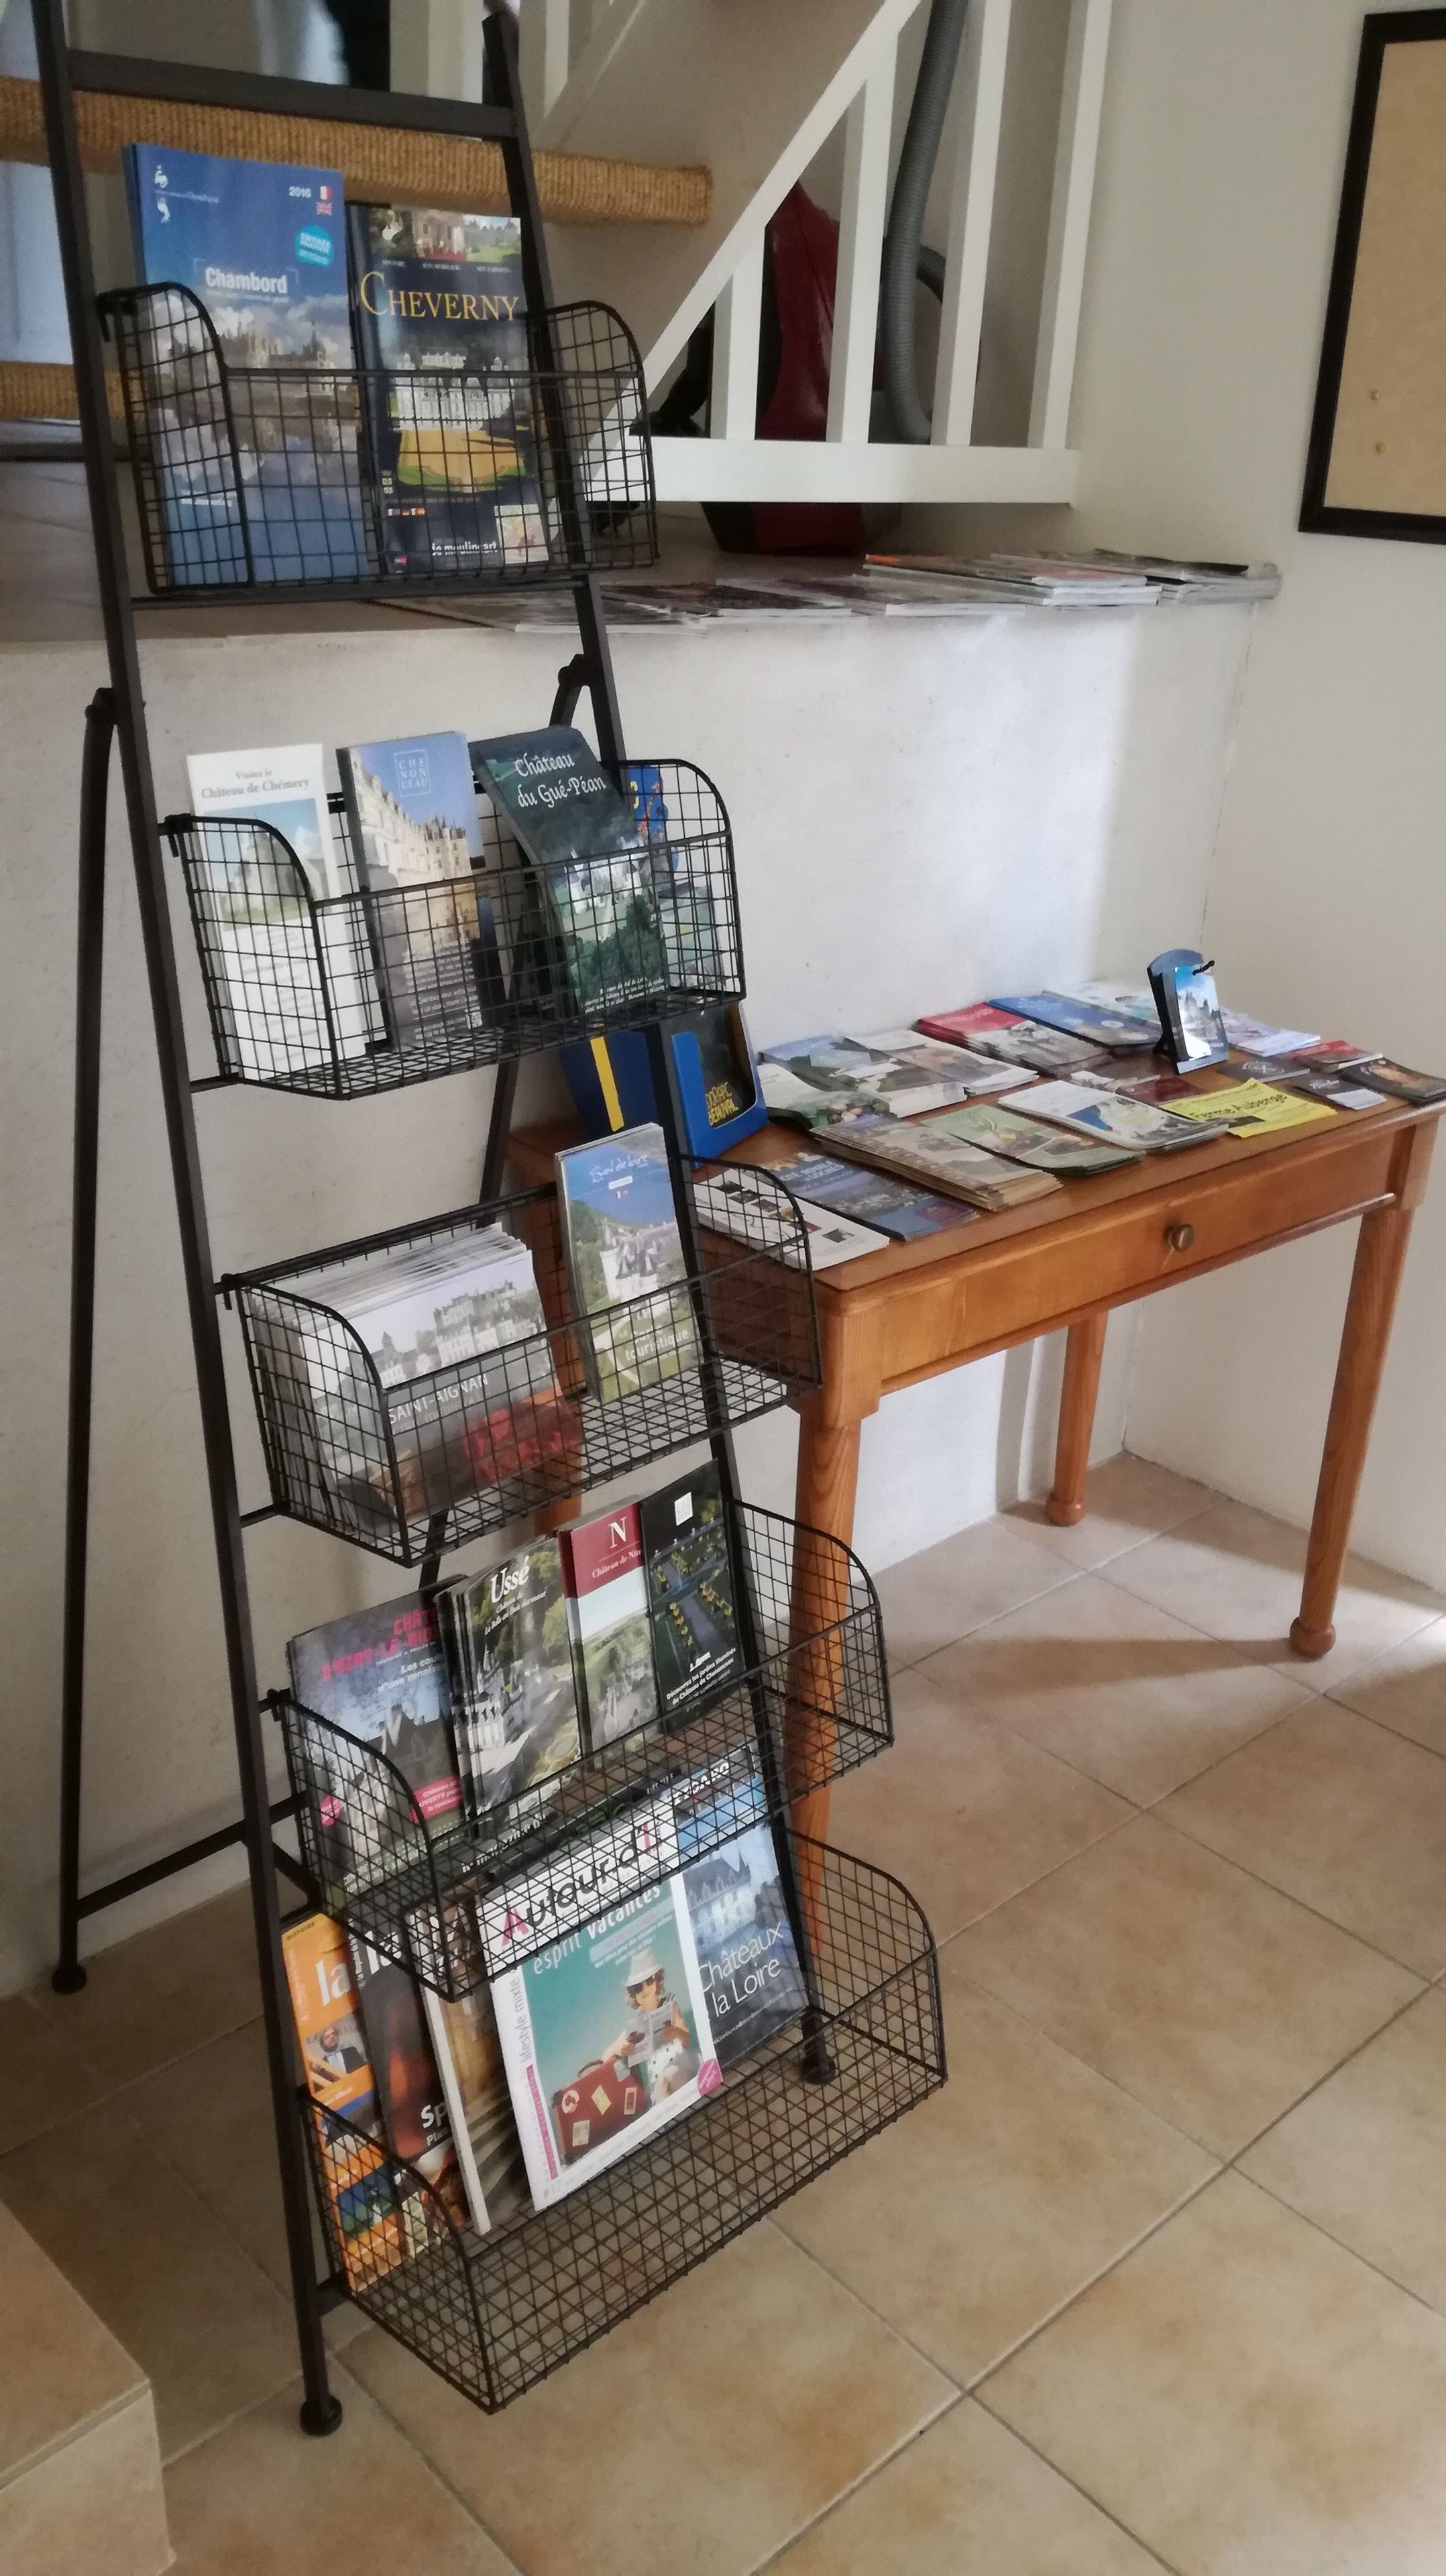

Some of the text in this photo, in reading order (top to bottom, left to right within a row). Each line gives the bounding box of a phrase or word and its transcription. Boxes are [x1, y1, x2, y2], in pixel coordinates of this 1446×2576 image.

[205, 267, 288, 294] Chambord
[359, 270, 519, 322] CHEVERNY
[235, 769, 273, 782] Visitez le
[398, 757, 426, 771] CHE
[400, 768, 427, 780] NON
[514, 752, 575, 778] Château
[201, 777, 310, 800] Château de Chémery
[516, 783, 538, 808] du
[538, 775, 607, 809] Gué-Péan
[624, 1330, 689, 1361] touristique
[388, 1373, 489, 1425] SAINT-AIGNAN
[608, 1516, 628, 1550] N
[490, 1555, 530, 1604] Ussé
[592, 1560, 619, 1579] Château
[586, 1886, 663, 1941] vacances
[700, 1920, 784, 1994] Châteaux
[711, 1992, 731, 2018] la
[732, 1957, 781, 2004] Loire
[515, 2015, 533, 2064] lifestyle
